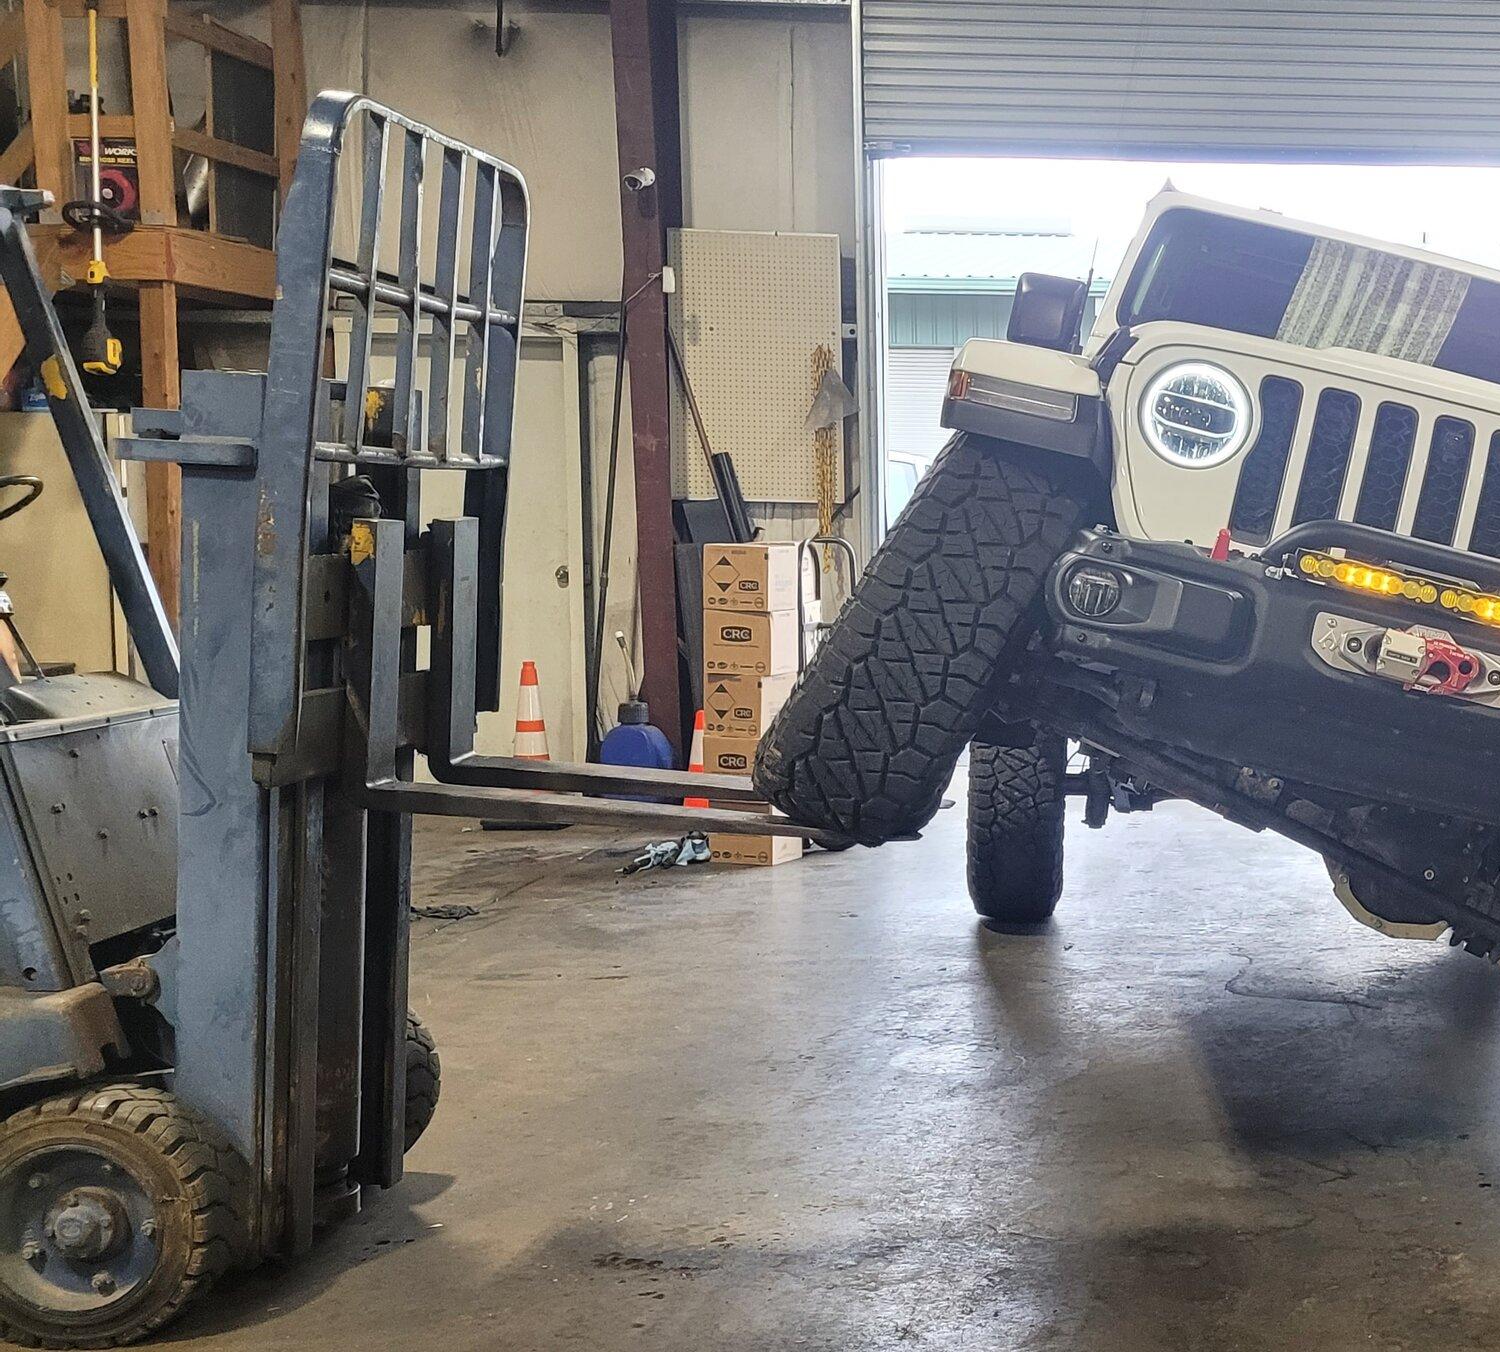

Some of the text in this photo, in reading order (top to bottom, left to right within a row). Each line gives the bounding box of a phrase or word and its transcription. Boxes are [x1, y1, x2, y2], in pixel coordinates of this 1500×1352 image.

[738, 580, 759, 591] CRC
[722, 628, 751, 639] CRC
[734, 708, 753, 718] CRC
[719, 756, 747, 768] CRC
